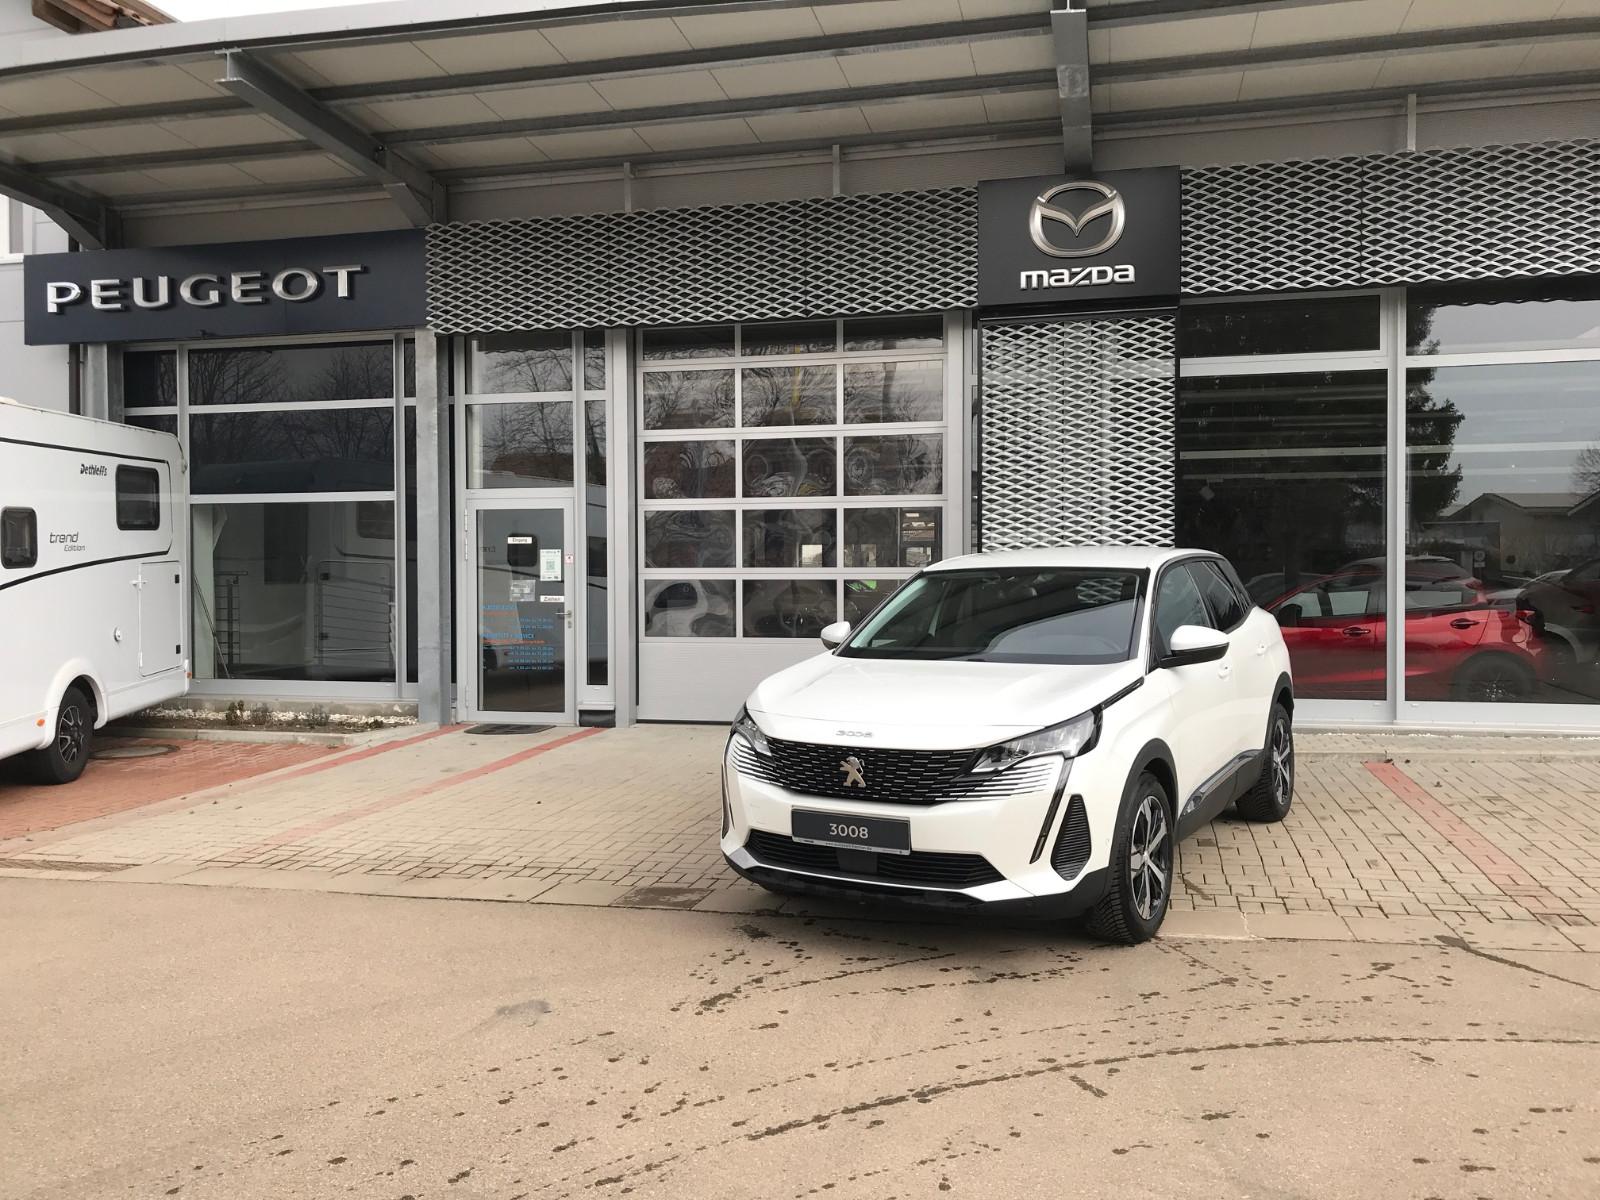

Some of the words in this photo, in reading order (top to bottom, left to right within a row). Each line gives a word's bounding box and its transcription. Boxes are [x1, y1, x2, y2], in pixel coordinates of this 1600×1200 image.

[47, 264, 362, 313] PEUGEOT
[80, 463, 108, 477] Dethleffs
[49, 531, 79, 544] trend
[63, 544, 86, 552] Edition
[835, 730, 873, 738] 3008
[829, 823, 869, 839] 3008
